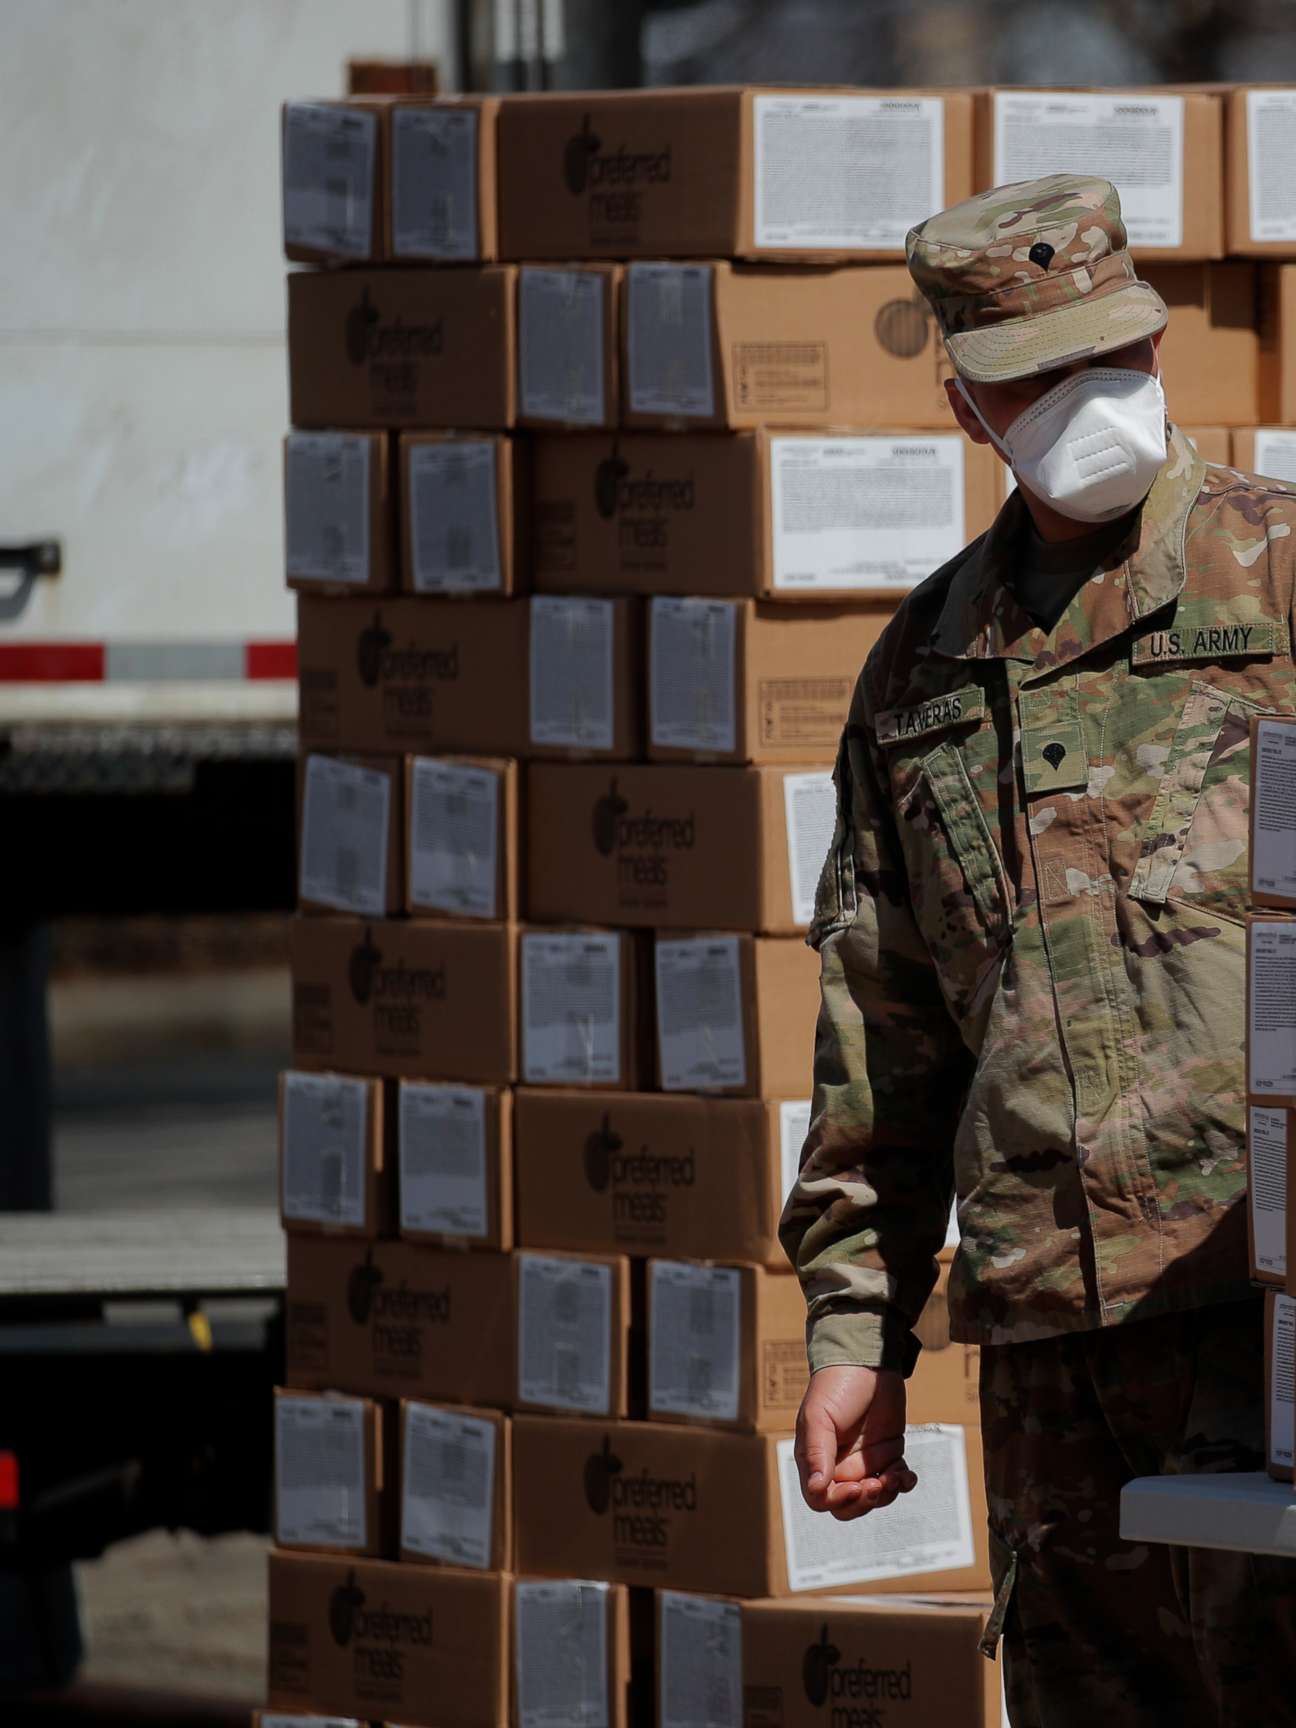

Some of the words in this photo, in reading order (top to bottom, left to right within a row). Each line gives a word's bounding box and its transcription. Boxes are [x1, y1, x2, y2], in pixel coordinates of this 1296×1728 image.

[1150, 633, 1185, 657] U.S.
[1193, 627, 1254, 655] ARMY
[893, 697, 963, 736] TAVERAS
[618, 808, 695, 850] preferred
[375, 957, 448, 1001] preferred
[612, 1145, 695, 1190] preferred
[614, 1190, 667, 1224] meals
[372, 1280, 451, 1323] preferred
[612, 1467, 697, 1512] preferred
[613, 1512, 668, 1548] meals
[354, 1603, 433, 1648] preferred
[831, 1658, 912, 1701] preferred
